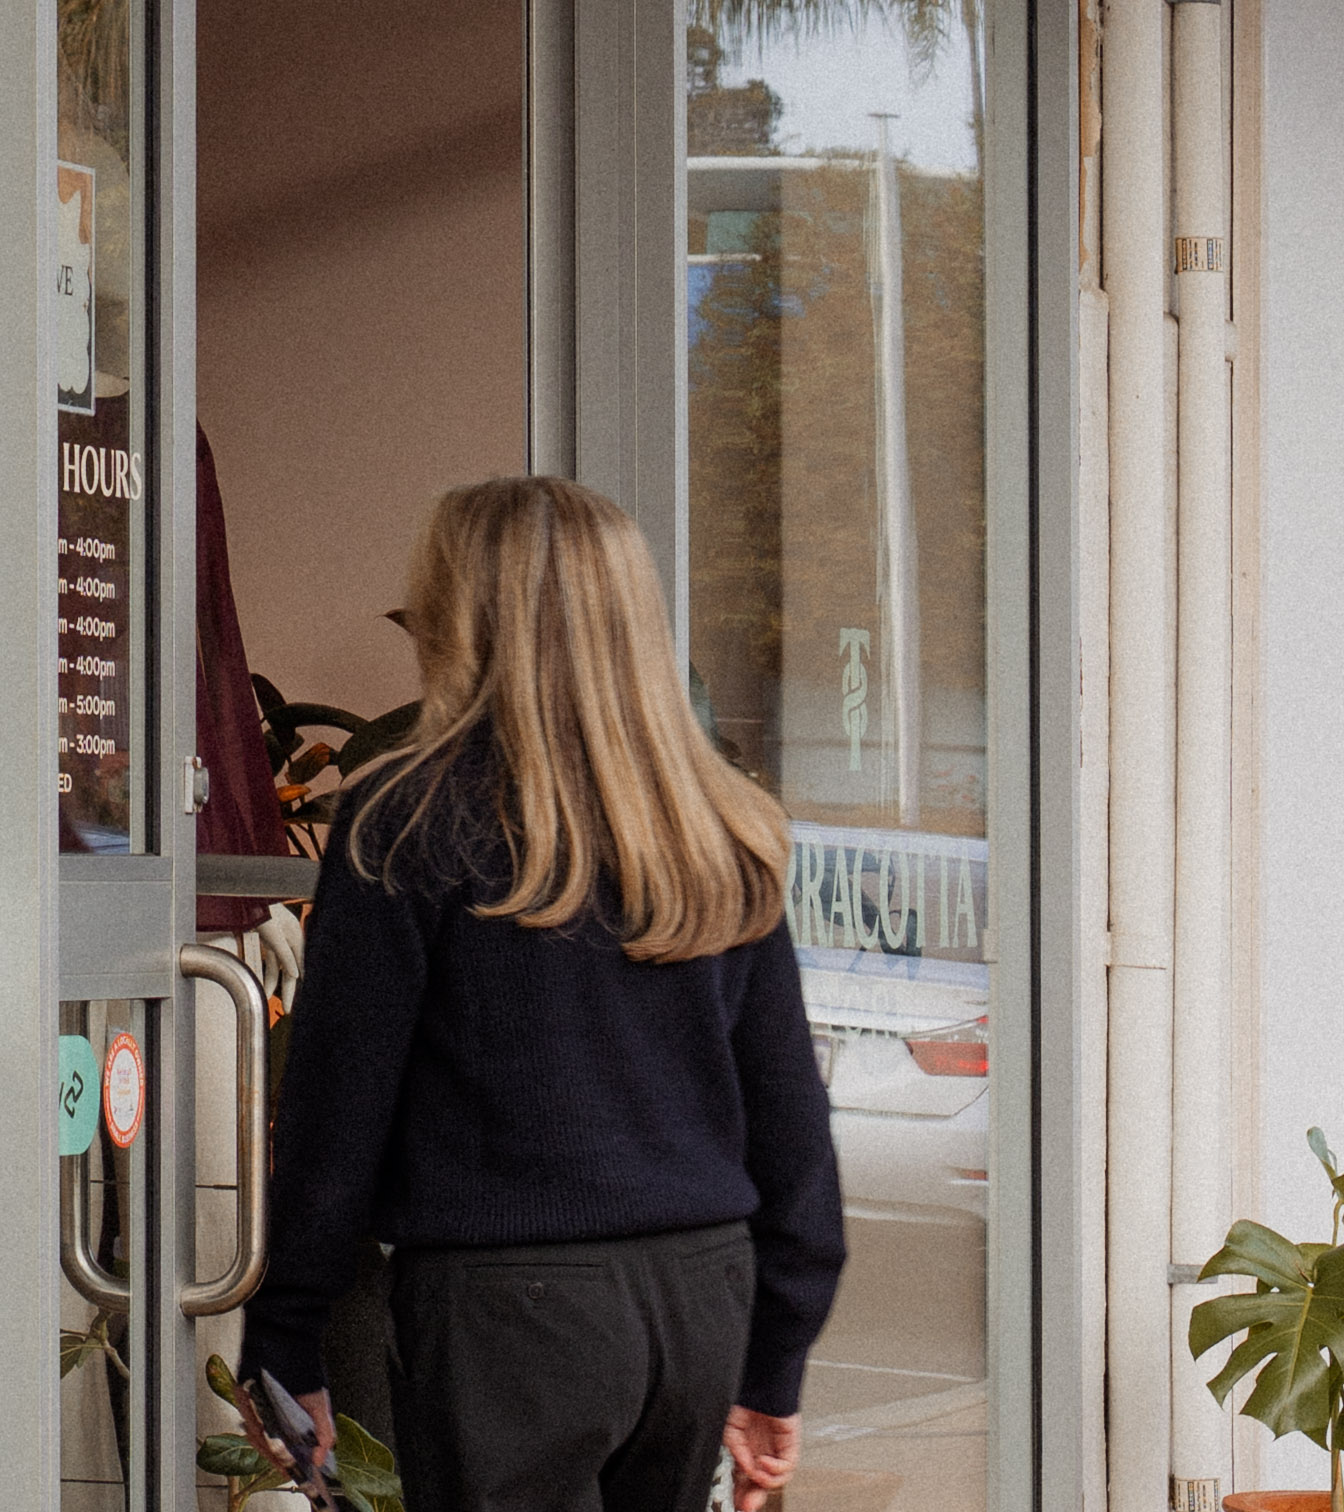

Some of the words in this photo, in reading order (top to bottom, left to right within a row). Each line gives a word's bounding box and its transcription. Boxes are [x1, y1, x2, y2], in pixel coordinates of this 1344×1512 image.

[62, 442, 142, 501] HOURS
[76, 537, 116, 564] 4:00pm
[76, 576, 116, 603] 4:00pm
[76, 616, 116, 642] 4:00pm
[76, 656, 116, 681] 4:00pm
[76, 695, 116, 720] 5:00pm
[76, 734, 116, 760] 3:00pm
